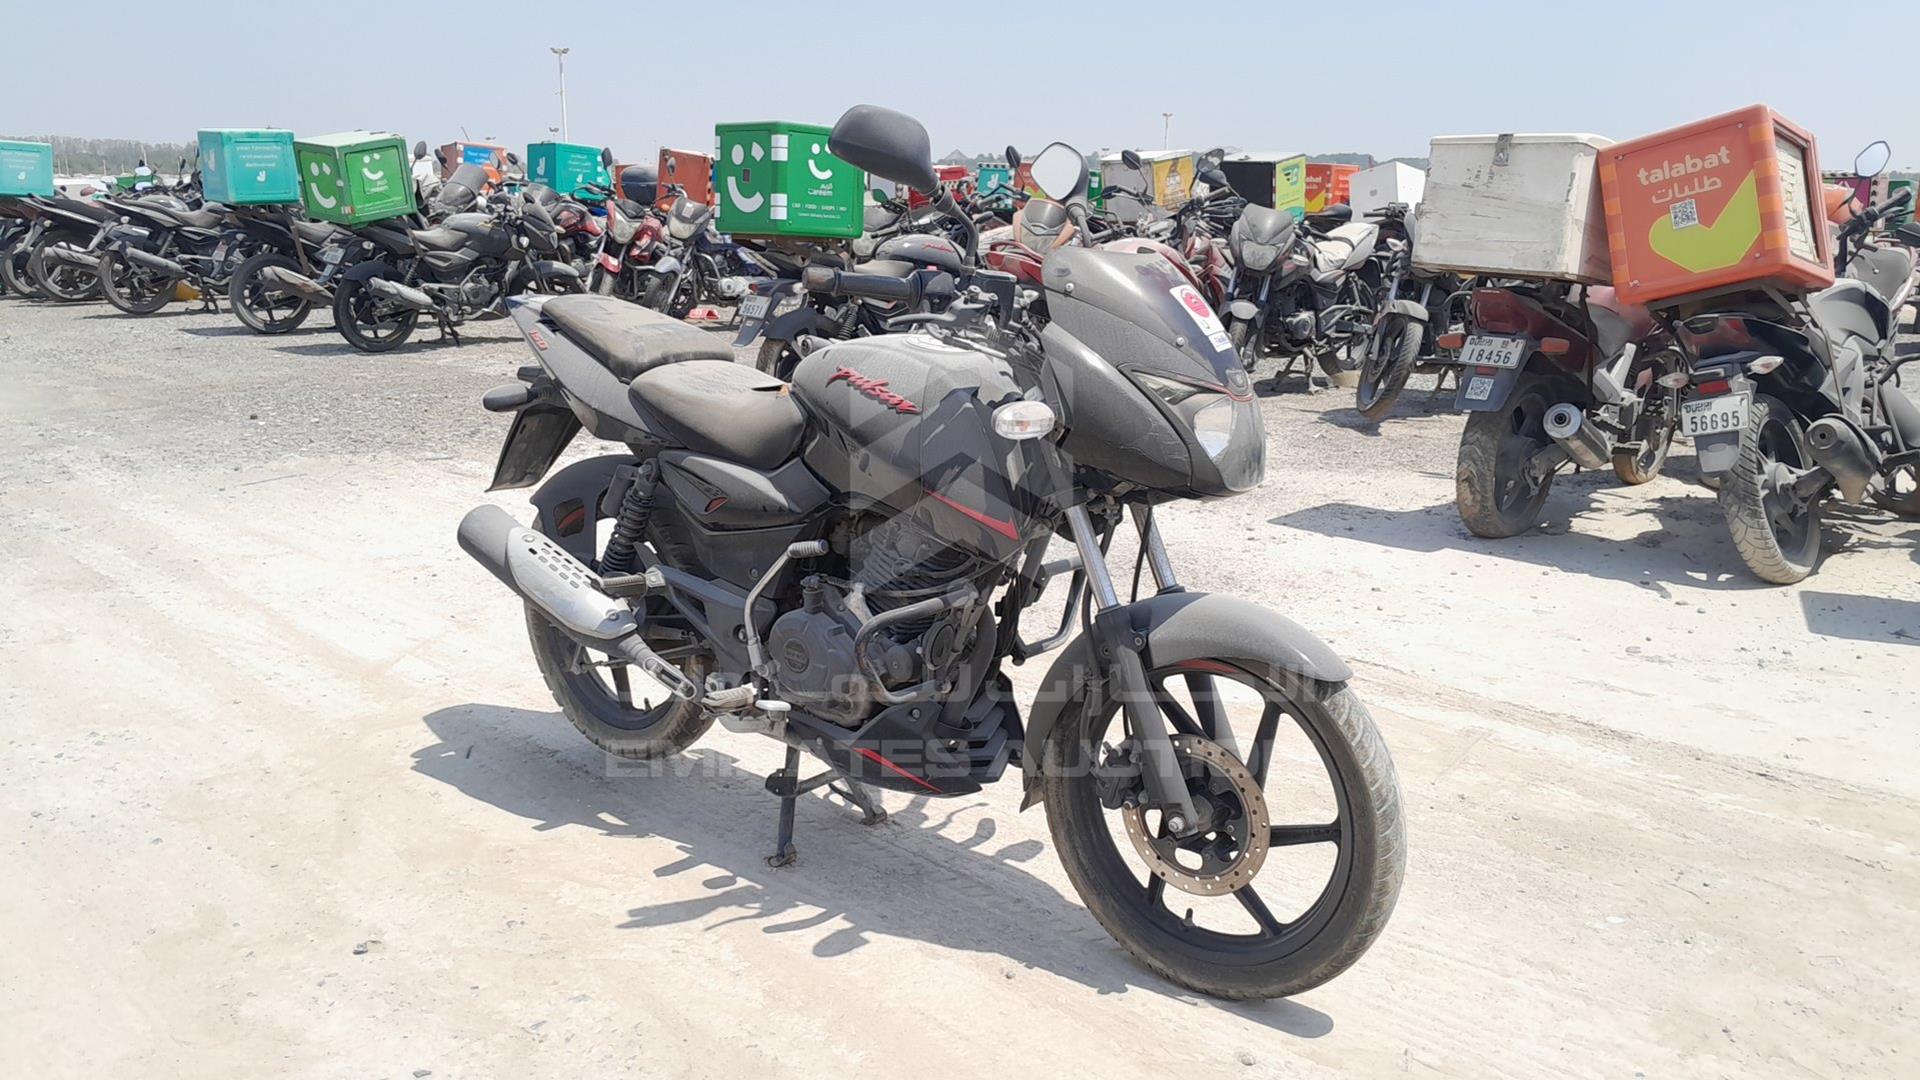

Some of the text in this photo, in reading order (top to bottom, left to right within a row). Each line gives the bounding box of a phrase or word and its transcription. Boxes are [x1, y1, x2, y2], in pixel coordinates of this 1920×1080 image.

[1637, 145, 1731, 186] talabat
[1651, 175, 1723, 204] طلبات
[1468, 347, 1512, 365] 18456
[1690, 410, 1740, 433] 56695
